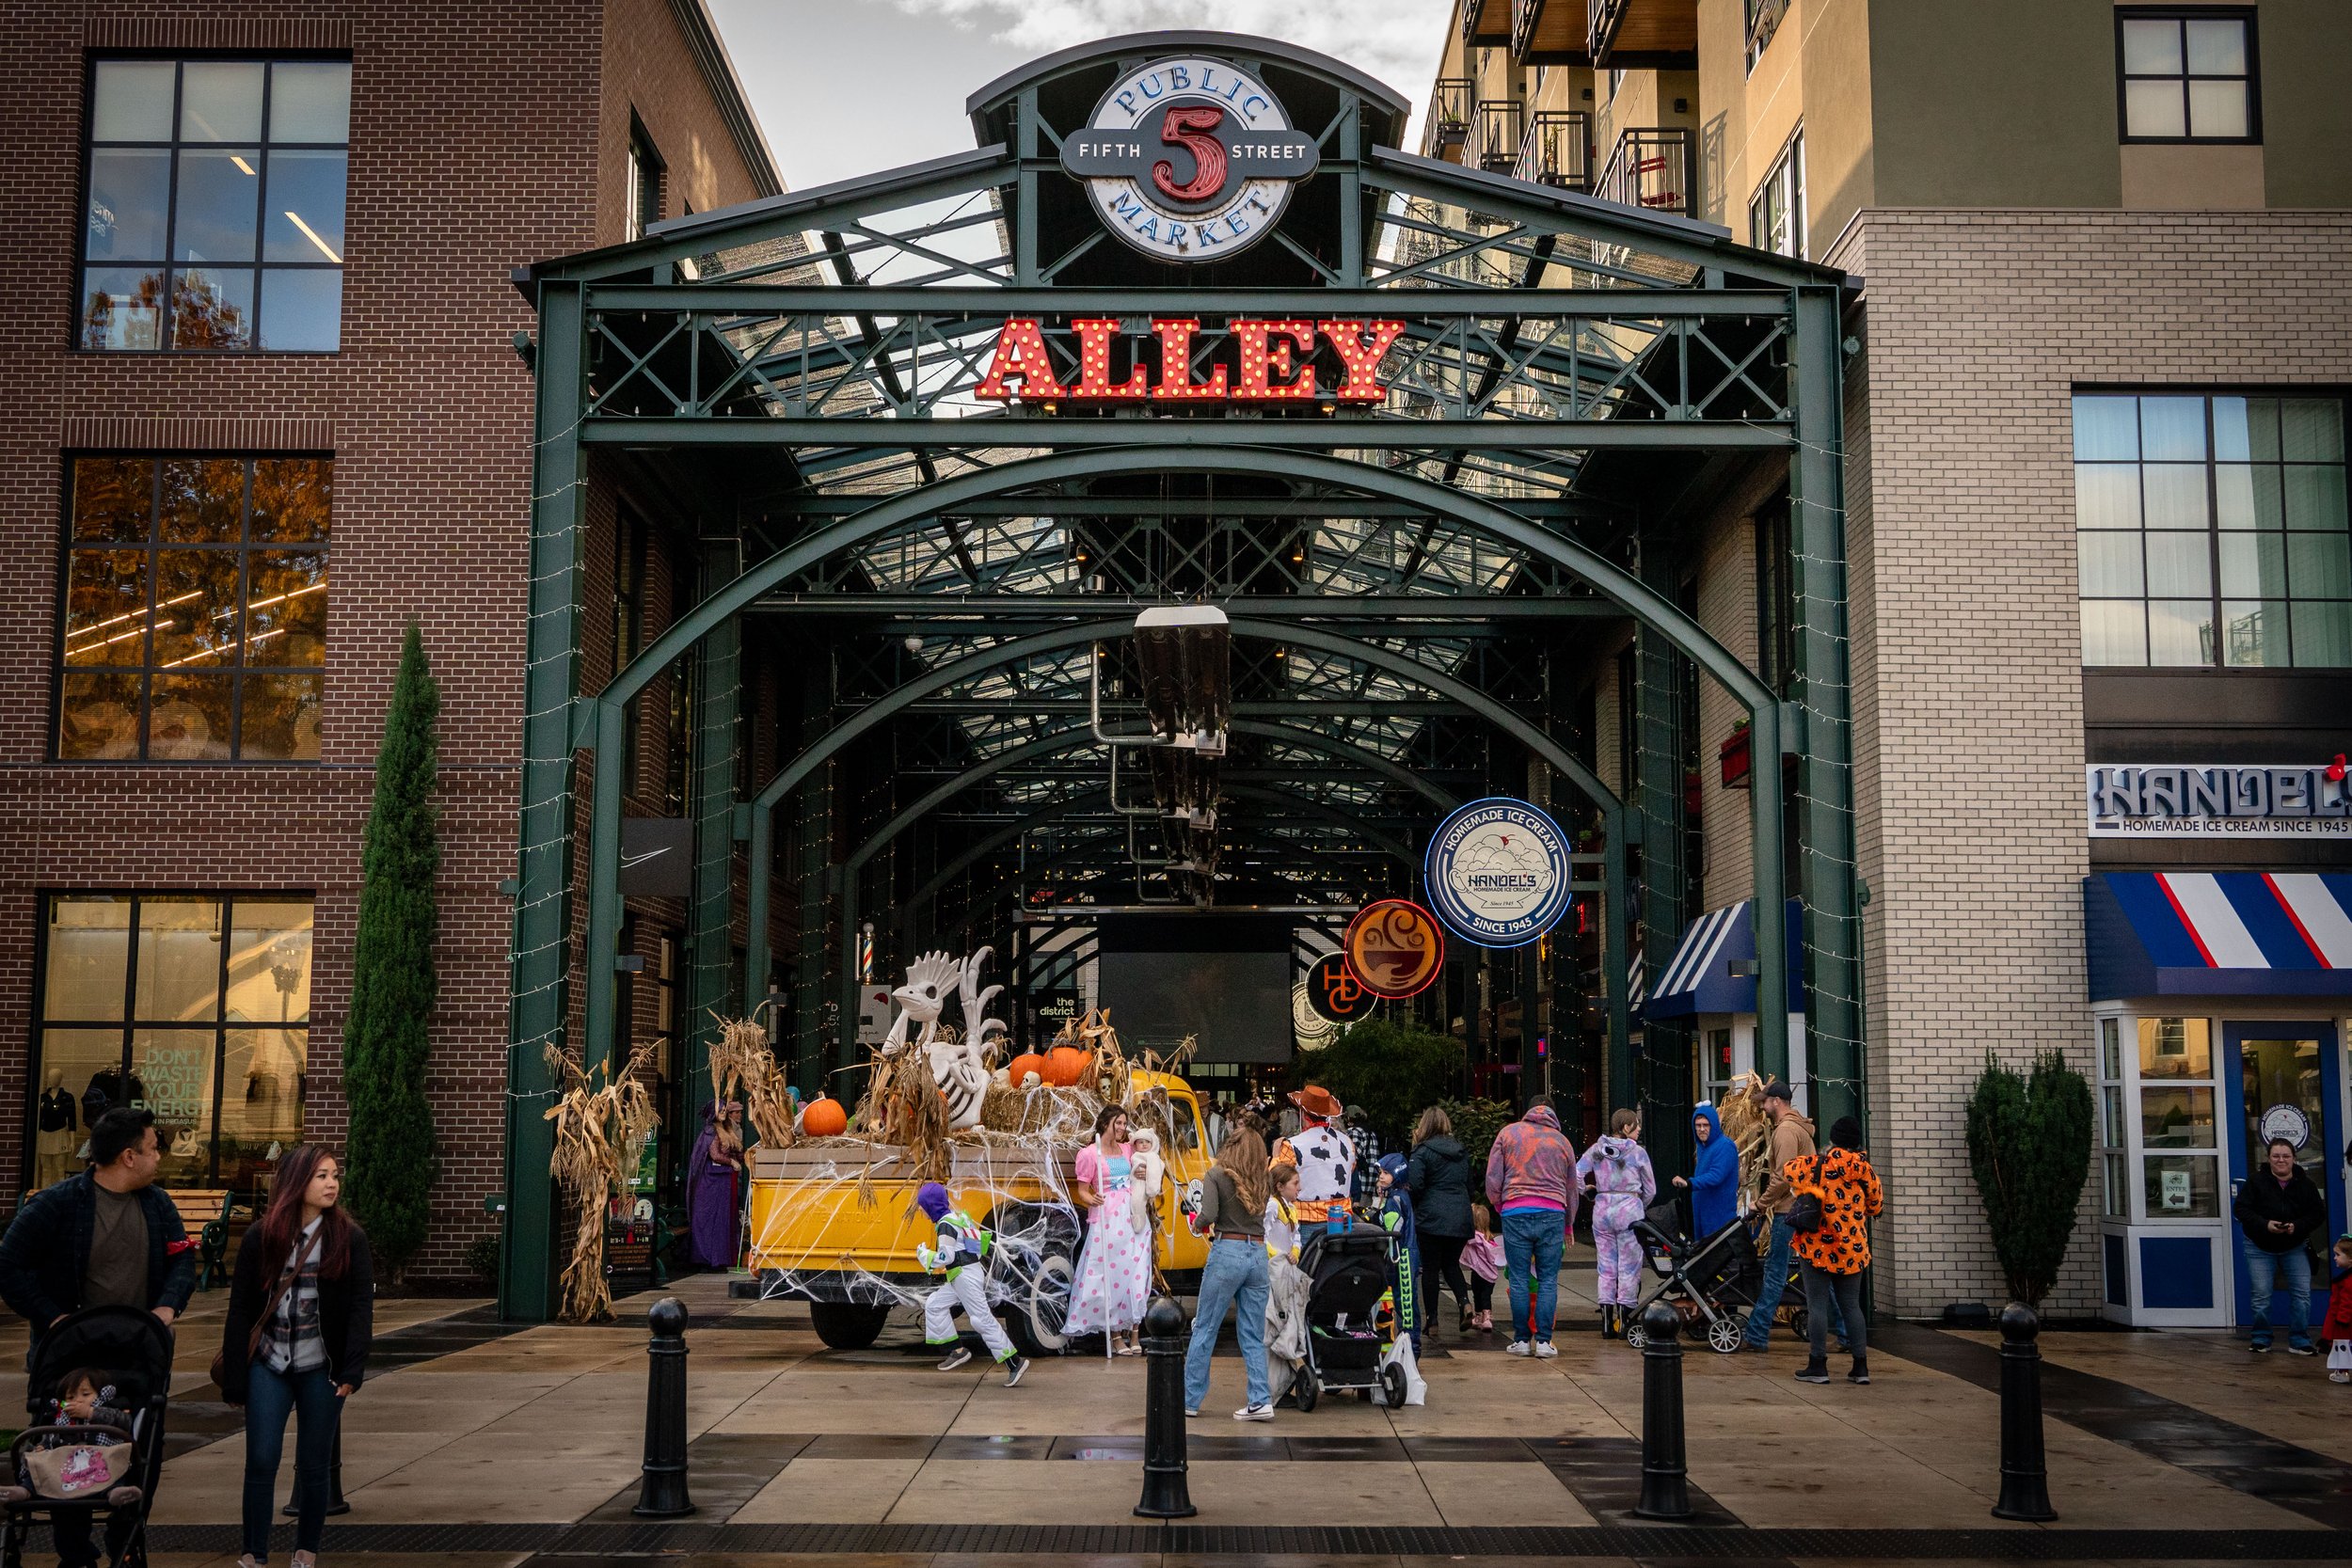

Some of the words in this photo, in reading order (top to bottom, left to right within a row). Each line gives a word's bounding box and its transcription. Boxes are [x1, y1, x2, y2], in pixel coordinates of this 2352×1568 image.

[1114, 65, 1270, 119] PUBLIC
[1079, 143, 1140, 158] FIFTH
[1232, 145, 1306, 159] STREET
[1152, 105, 1228, 200] 5
[1112, 190, 1270, 247] MARKET
[974, 319, 1406, 404] ALLEY
[2094, 756, 2352, 817] HANDEL'
[1445, 810, 1503, 851] HOMEMADE
[1507, 810, 1525, 824] ICE
[1525, 817, 1558, 853] CREAM
[2123, 820, 2200, 832] HOMEMADE
[2203, 820, 2221, 832] ICE
[2225, 821, 2270, 832] CREAM
[2273, 821, 2312, 832] SINCE
[2317, 821, 2348, 832] 1945
[1468, 873, 1536, 887] HANDEL'S
[1472, 917, 1505, 933] SINCE
[1507, 917, 1533, 933] 1945
[1057, 997, 1074, 1006] the
[1040, 1006, 1074, 1016] district
[146, 1049, 201, 1065] DON'T
